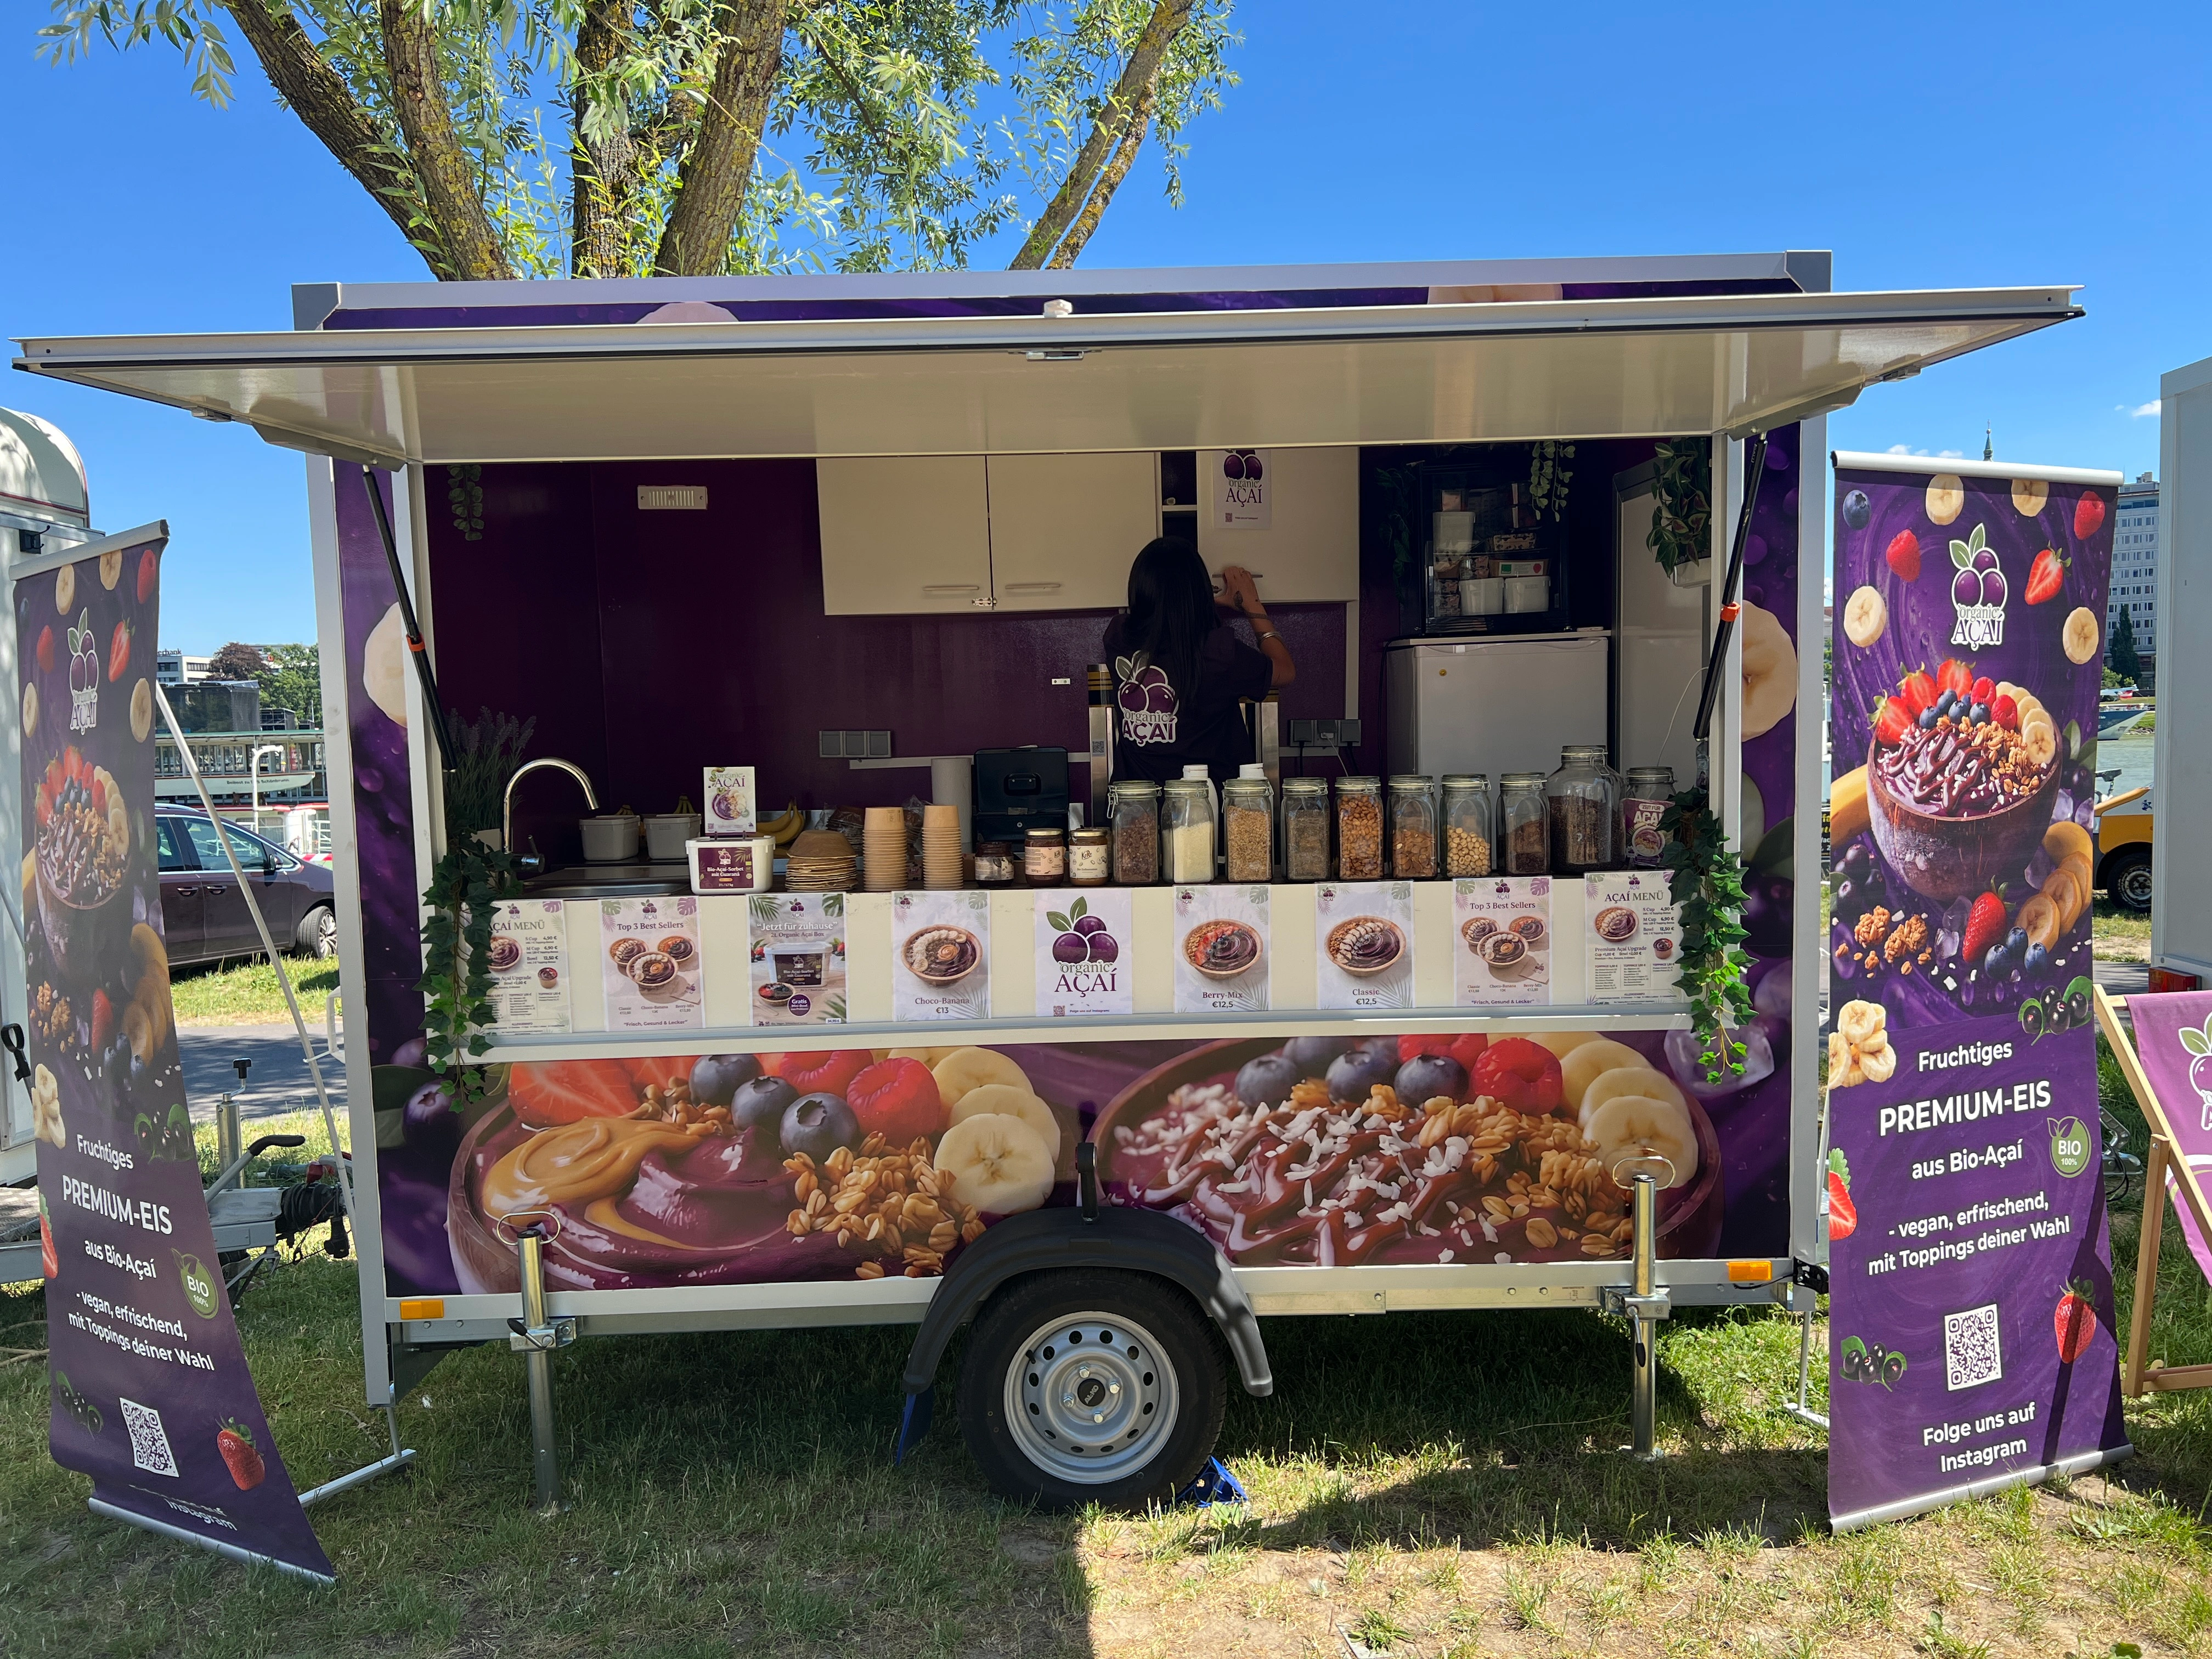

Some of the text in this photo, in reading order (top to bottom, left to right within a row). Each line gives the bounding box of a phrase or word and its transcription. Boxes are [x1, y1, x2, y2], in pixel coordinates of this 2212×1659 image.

[1229, 479, 1259, 490] organic
[1226, 484, 1262, 507] AÇAÍ
[1959, 605, 1999, 623] organic
[1953, 613, 2003, 648] AÇAÍ
[1125, 710, 1172, 724] organic
[1123, 718, 1177, 744] AÇAÍ
[714, 775, 745, 789] AÇAÍ
[1605, 890, 1663, 904] AÇAÍ MENÜ
[514, 919, 545, 930] MENÜ
[784, 922, 796, 930] für
[1060, 961, 1111, 976] organic
[1054, 967, 1118, 998] AÇAÍ
[1352, 988, 1380, 996] Classic
[915, 997, 970, 1005] Choco-Banana
[1202, 991, 1243, 1001] Berry-Mix
[1212, 1001, 1233, 1009] €12,5
[1356, 998, 1377, 1006] €12,5
[936, 1006, 949, 1014] €13
[1918, 1041, 2012, 1072] Fruchtiges
[1880, 1080, 2051, 1136] PREMIUM-EIS
[77, 1134, 133, 1170] Fruchtiges
[2058, 1140, 2081, 1156] BIO
[1912, 1139, 2023, 1180] aus Bio-Açaí
[2061, 1158, 2078, 1166] 100%
[62, 1175, 173, 1235] PREMIUM-EIS
[1898, 1215, 1953, 1238] vegan,
[1957, 1191, 2049, 1226] erfrischend,
[1868, 1216, 2070, 1276] mit Toppings deiner Wahl
[84, 1240, 157, 1280] aus Bio-Açaí
[187, 1275, 209, 1298] BIO
[193, 1294, 209, 1308] 100%
[81, 1291, 113, 1318] vegan,
[115, 1304, 188, 1341] erfrischend,
[68, 1312, 216, 1371] mit Toppings deiner Wahl
[1084, 1385, 1099, 1404] AL-KO
[1923, 1401, 2036, 1447] Folge uns auf
[1941, 1437, 2027, 1473] Instagram
